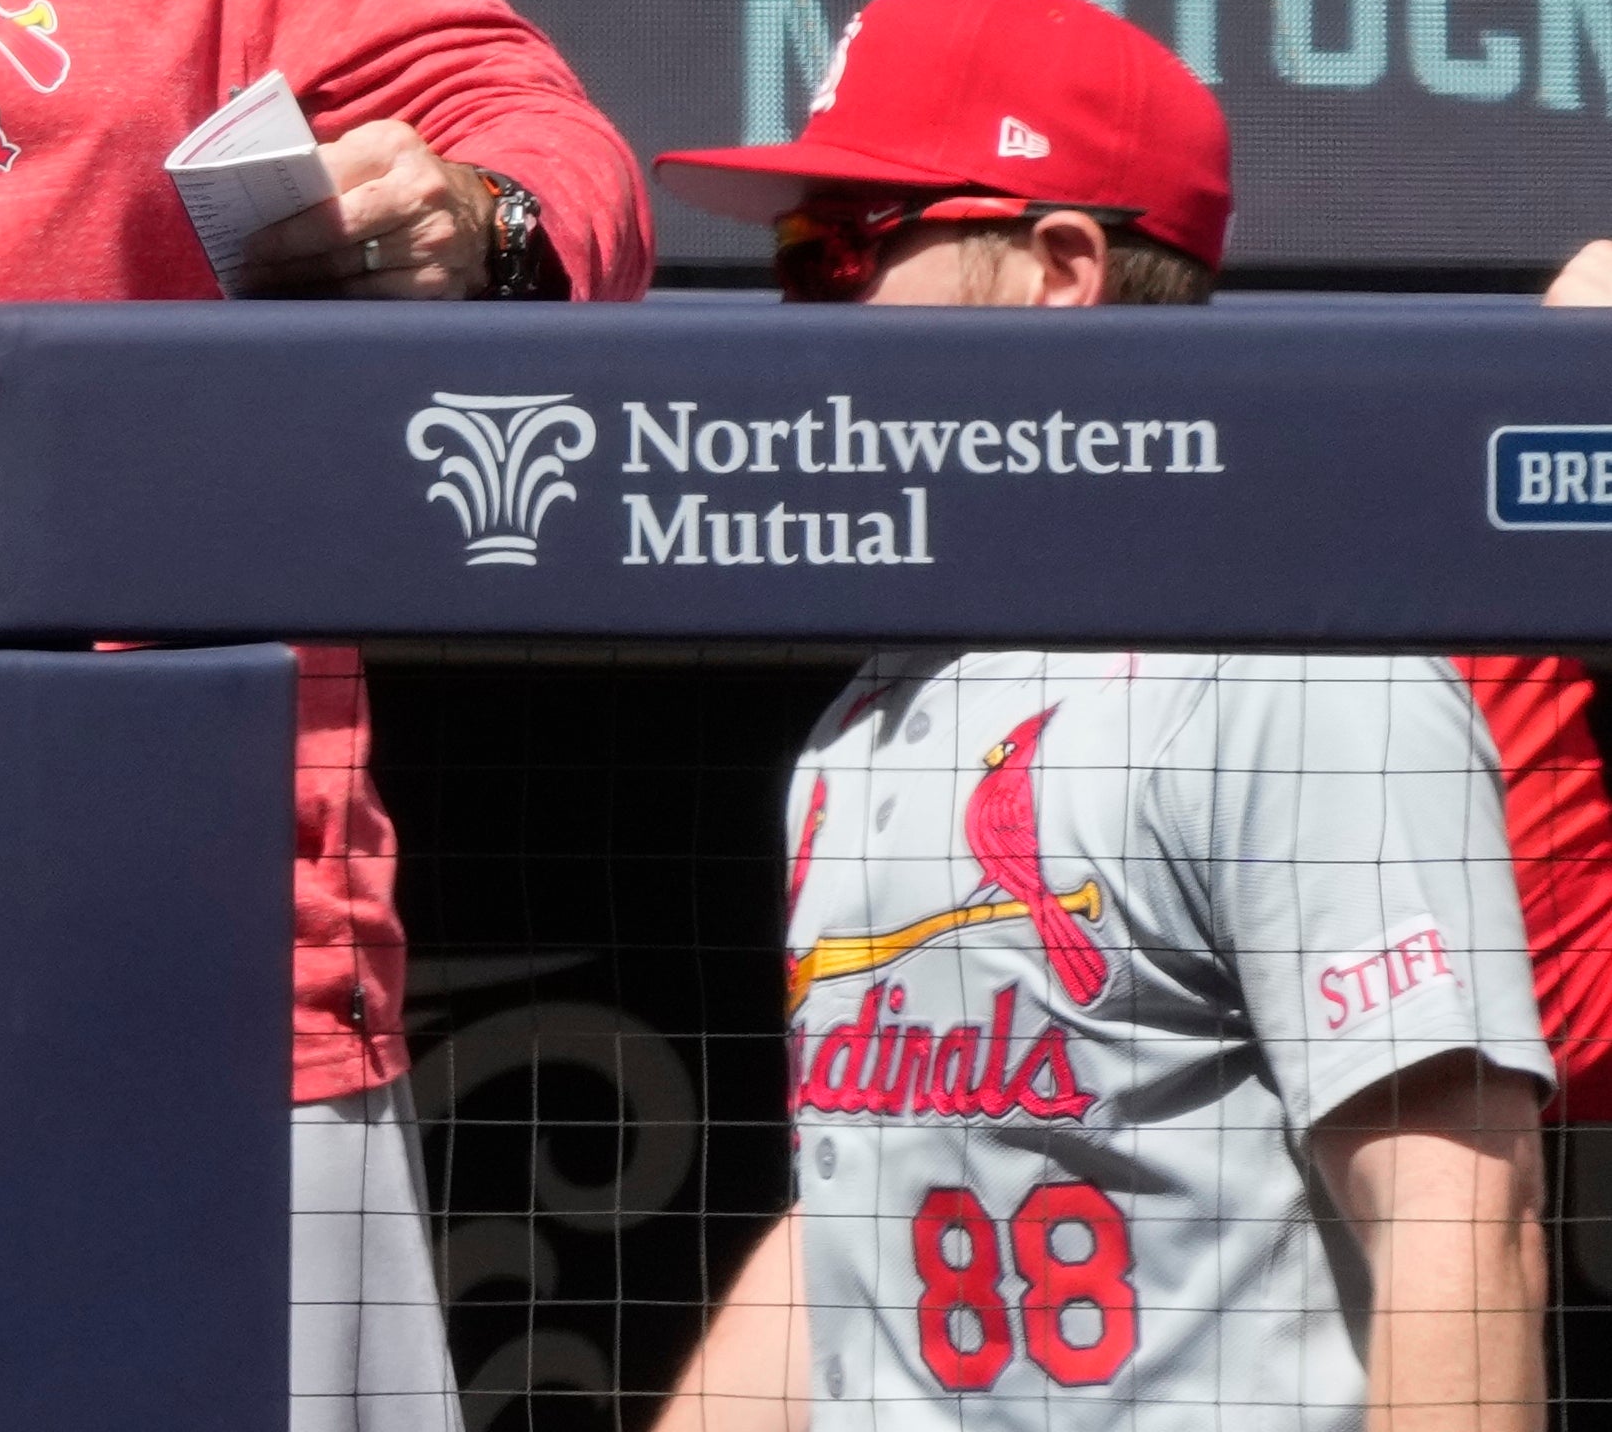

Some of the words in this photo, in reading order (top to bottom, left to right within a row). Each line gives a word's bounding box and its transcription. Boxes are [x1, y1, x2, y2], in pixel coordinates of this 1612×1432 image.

[622, 394, 1225, 476] Northwestern
[622, 487, 934, 567] Mutual
[1319, 928, 1465, 1031] STIF
[787, 976, 1100, 1126] dinals
[910, 1181, 1142, 1393] 88
